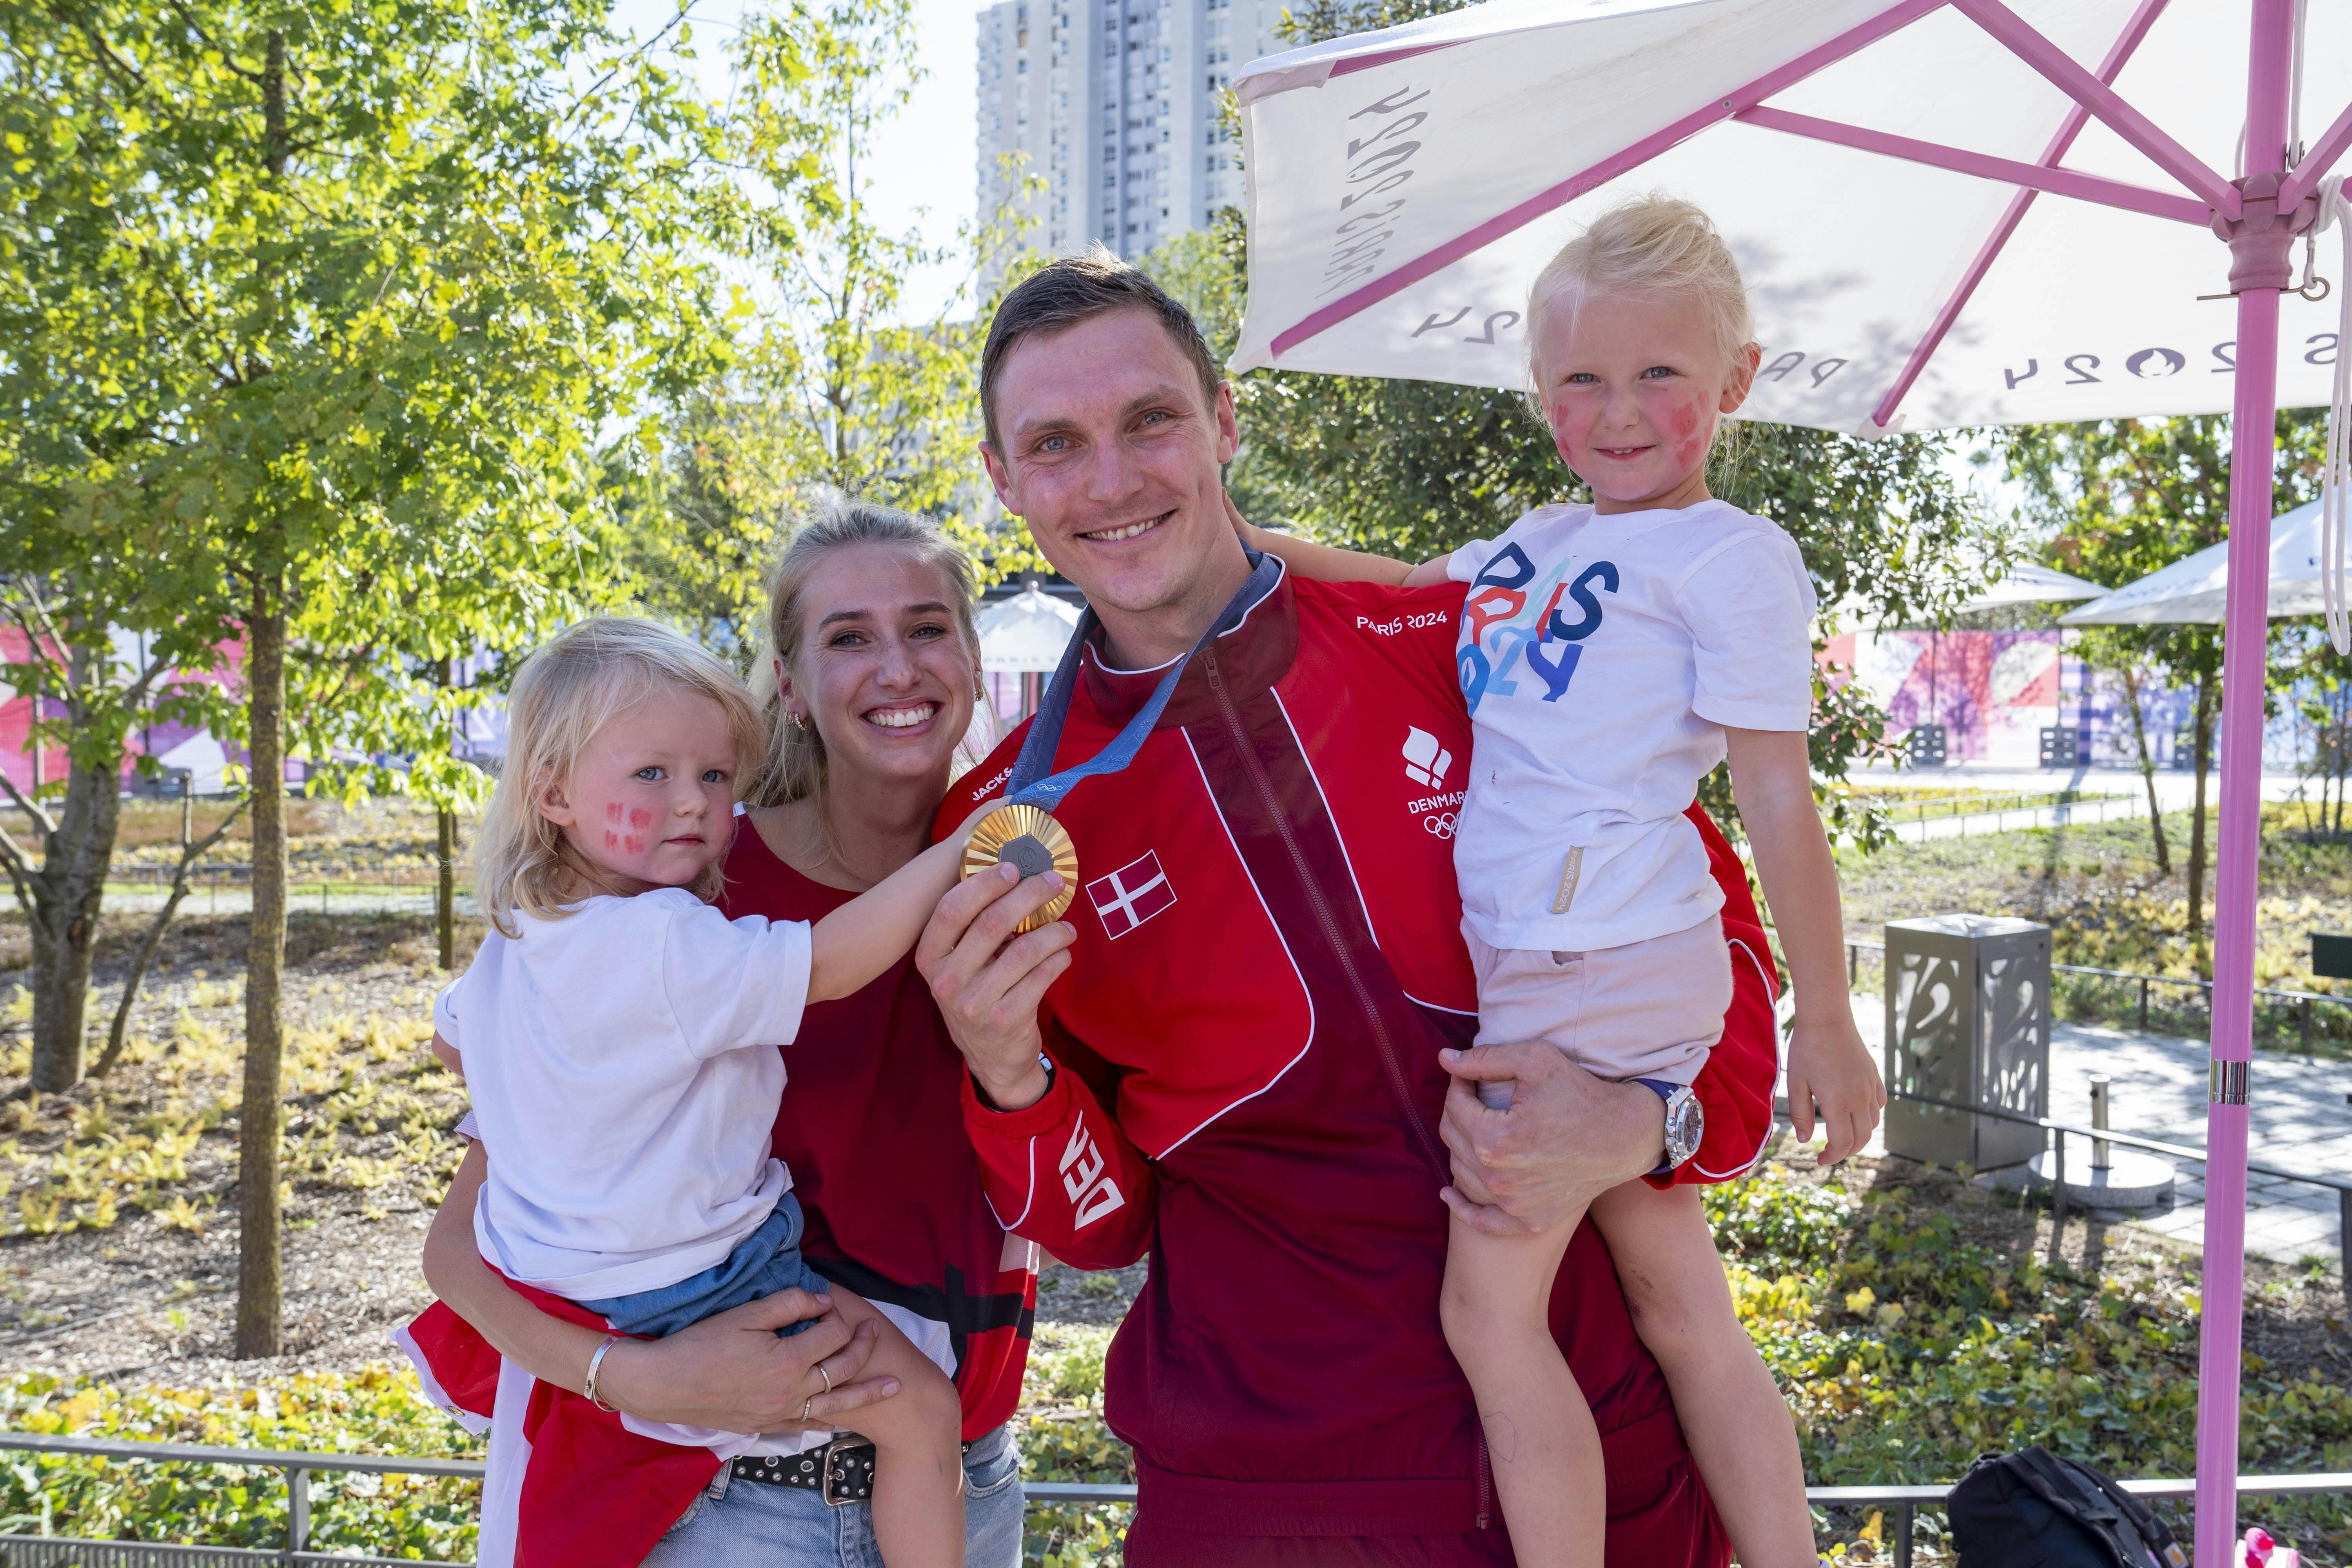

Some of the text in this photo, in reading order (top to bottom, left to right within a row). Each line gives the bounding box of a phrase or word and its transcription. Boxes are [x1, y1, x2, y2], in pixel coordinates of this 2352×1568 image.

[1357, 611, 1448, 636] PARIS 2024
[972, 762, 1016, 801] JACK&
[1408, 790, 1468, 814] DENMAR
[1557, 882, 1572, 910] 2024
[1058, 1109, 1125, 1231] DEN
